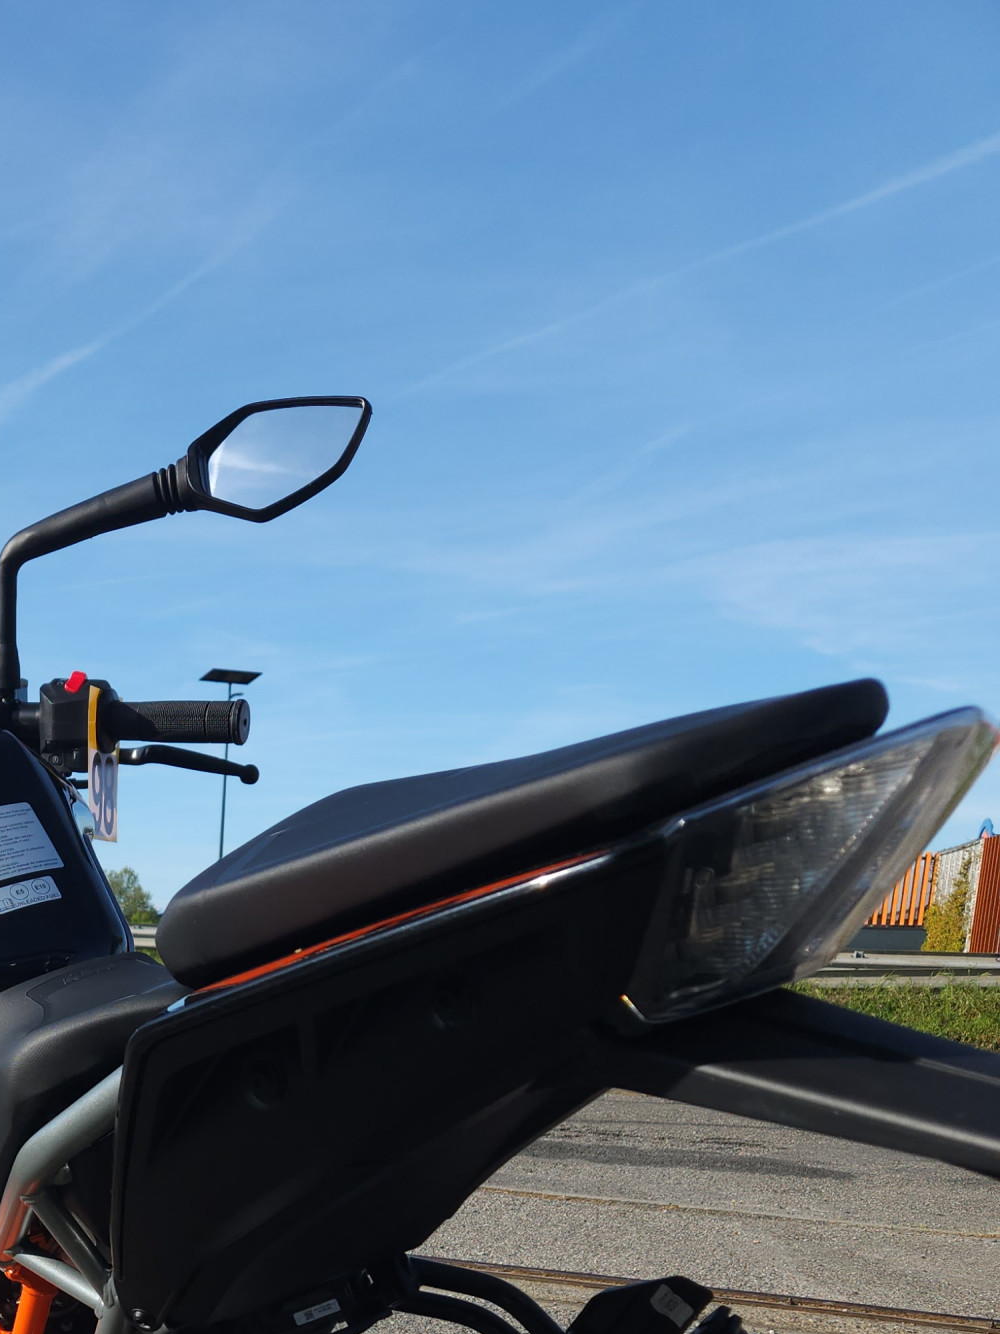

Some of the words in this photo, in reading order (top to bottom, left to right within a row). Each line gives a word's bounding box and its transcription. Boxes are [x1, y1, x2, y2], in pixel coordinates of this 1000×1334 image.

[91, 751, 115, 836] 98
[34, 882, 47, 891] E10
[15, 888, 25, 896] E5
[14, 896, 46, 907] UNLEADED
